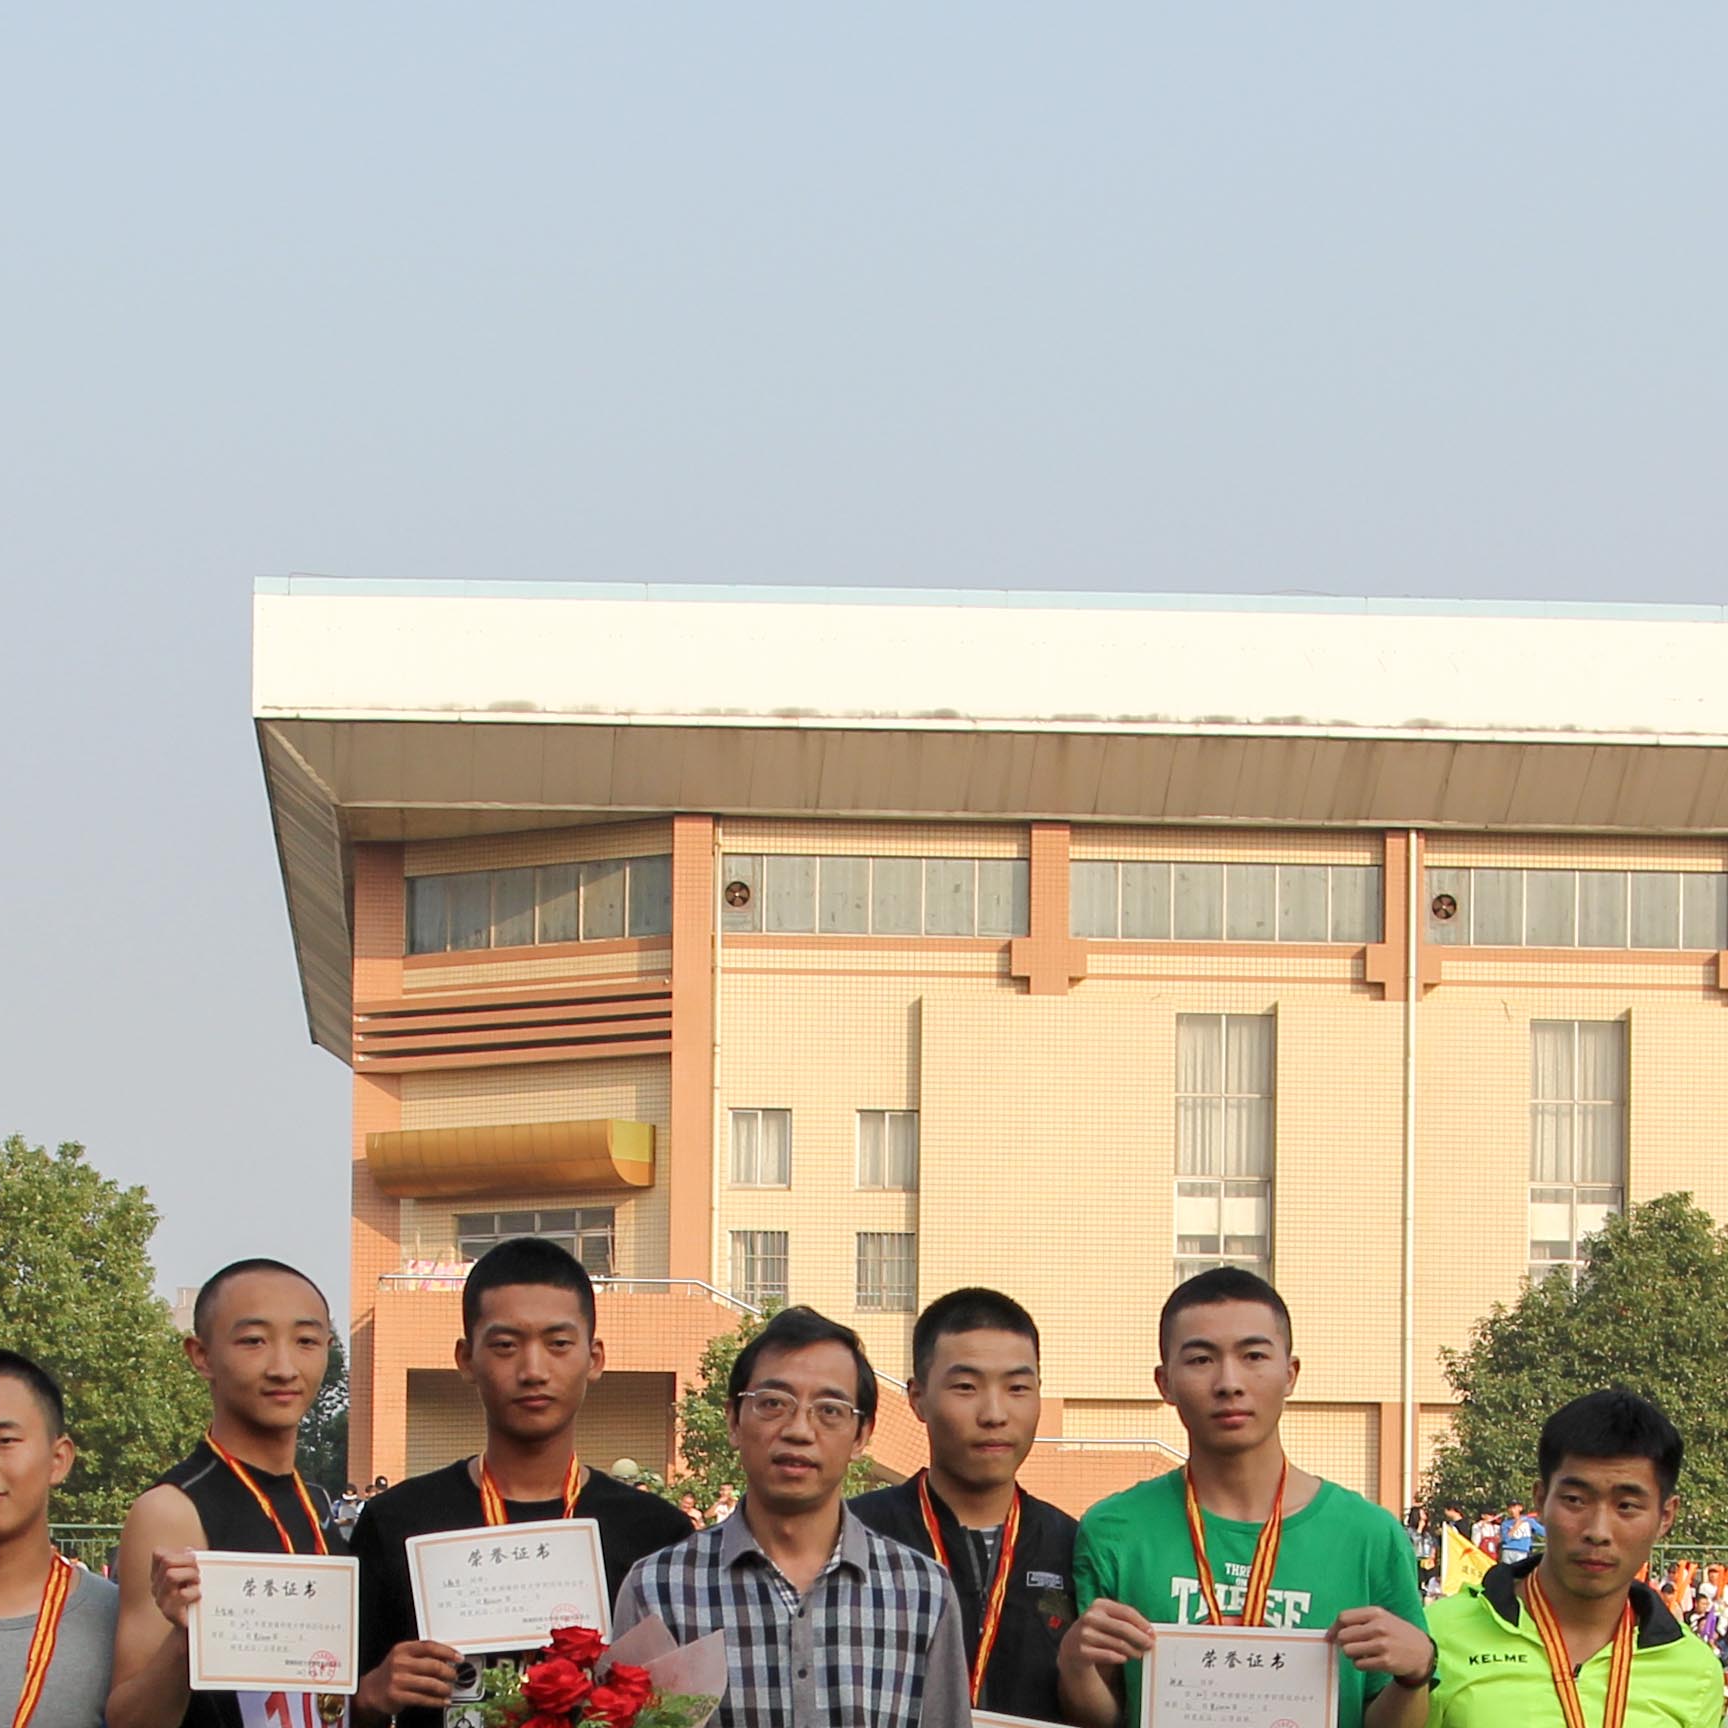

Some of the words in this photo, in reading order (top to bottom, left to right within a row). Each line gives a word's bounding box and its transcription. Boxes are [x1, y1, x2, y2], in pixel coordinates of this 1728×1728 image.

[467, 1543, 551, 1567] 荣誉证书
[1225, 1563, 1252, 1577] THRE
[242, 1578, 317, 1599] 荣誉证书
[1201, 1649, 1286, 1670] 荣誉证书
[1467, 1654, 1527, 1667] KELME
